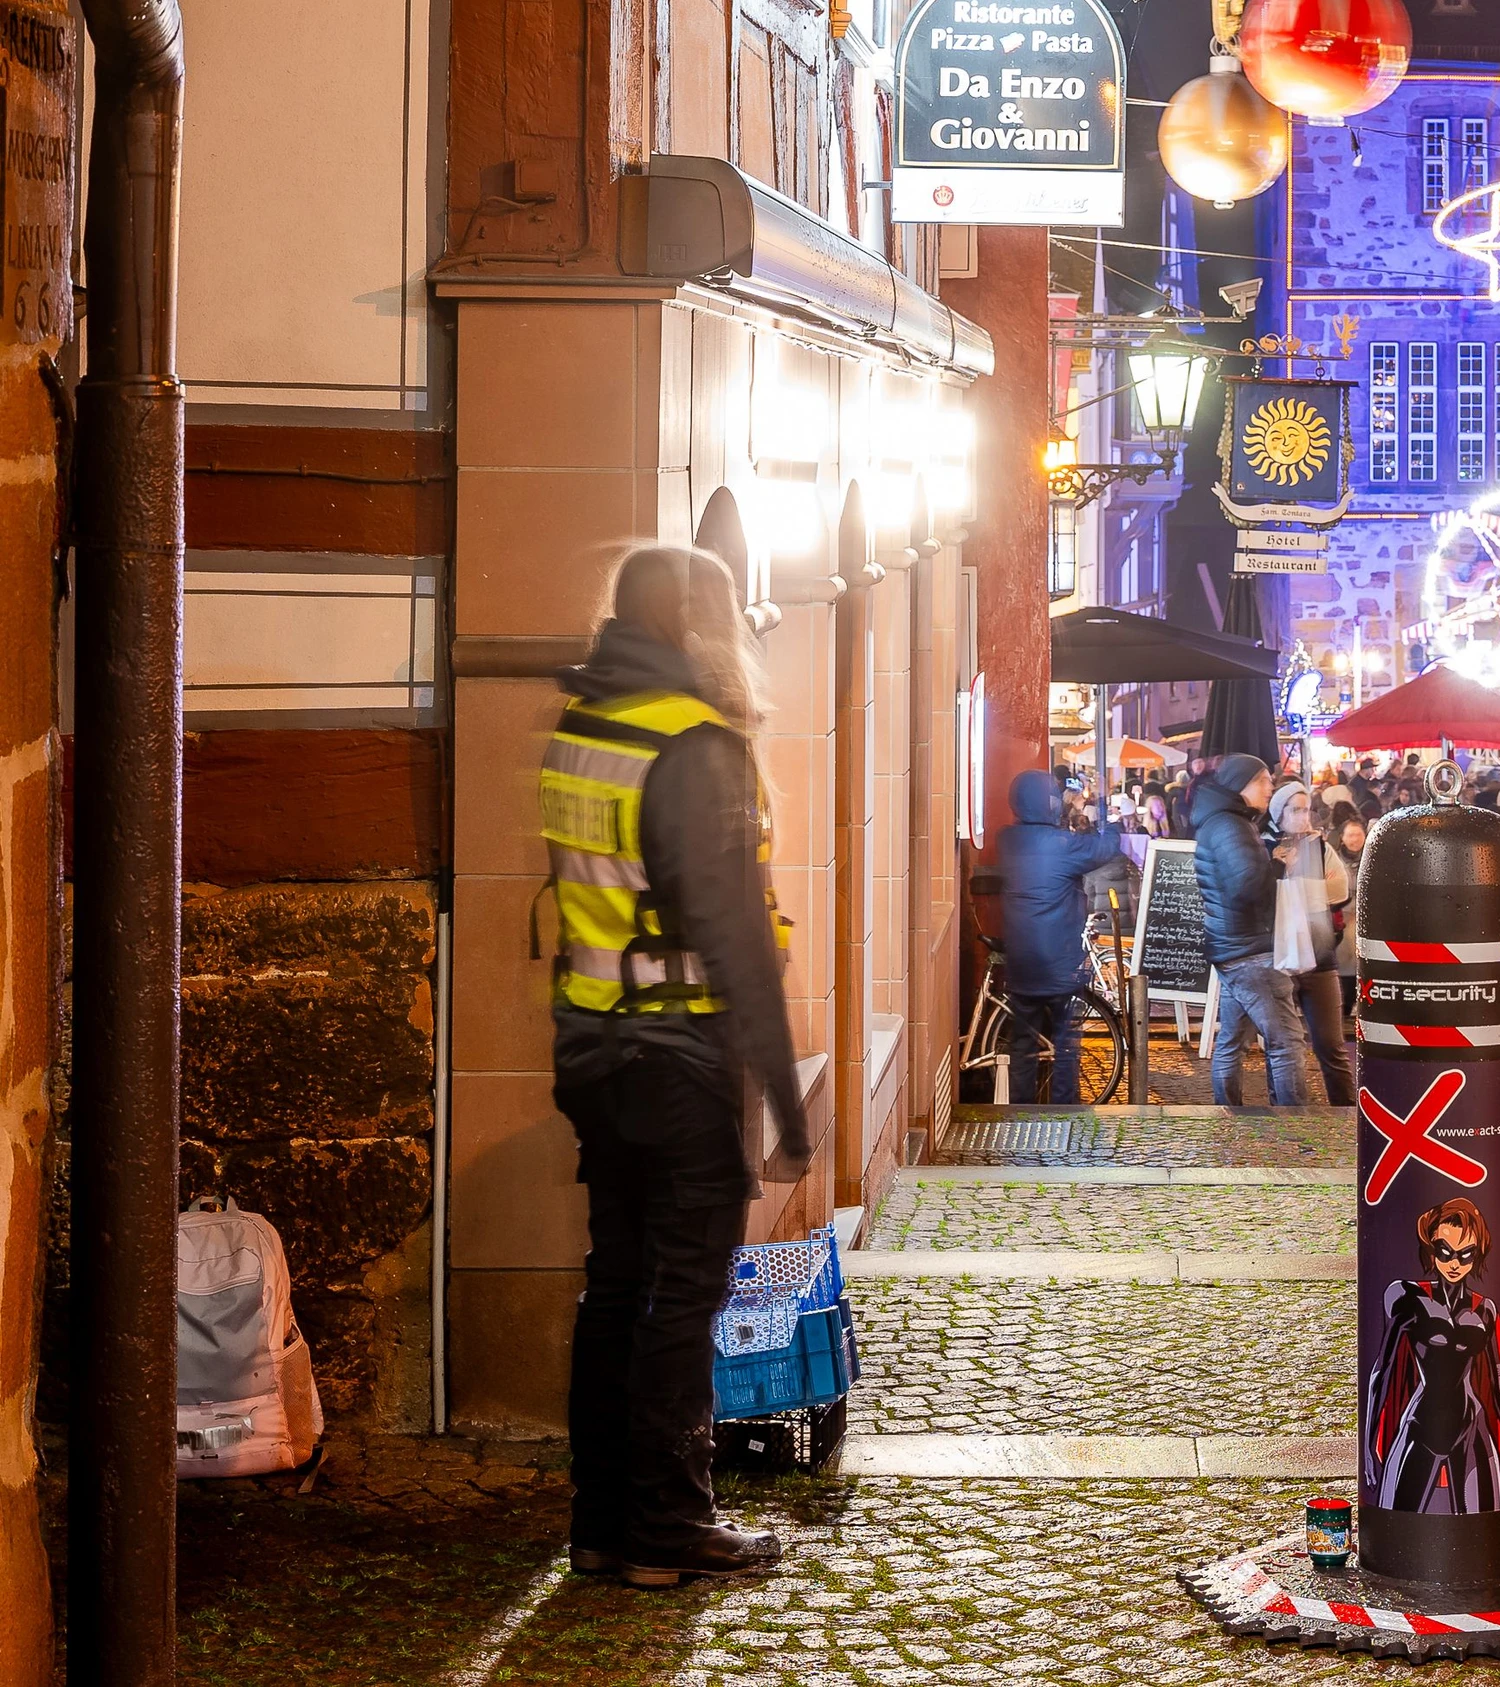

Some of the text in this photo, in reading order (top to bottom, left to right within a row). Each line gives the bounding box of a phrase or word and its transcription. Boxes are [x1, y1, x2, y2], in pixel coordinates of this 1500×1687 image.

[954, 1, 1075, 25] Ristorante
[931, 27, 1094, 53] Pizza Pasta
[939, 66, 1086, 100] Da Enzo
[998, 102, 1024, 124] &
[929, 117, 1090, 151] Giovanni
[1266, 534, 1301, 548] Hotel
[1247, 557, 1317, 571] Restaurant
[1403, 985, 1496, 1003] security
